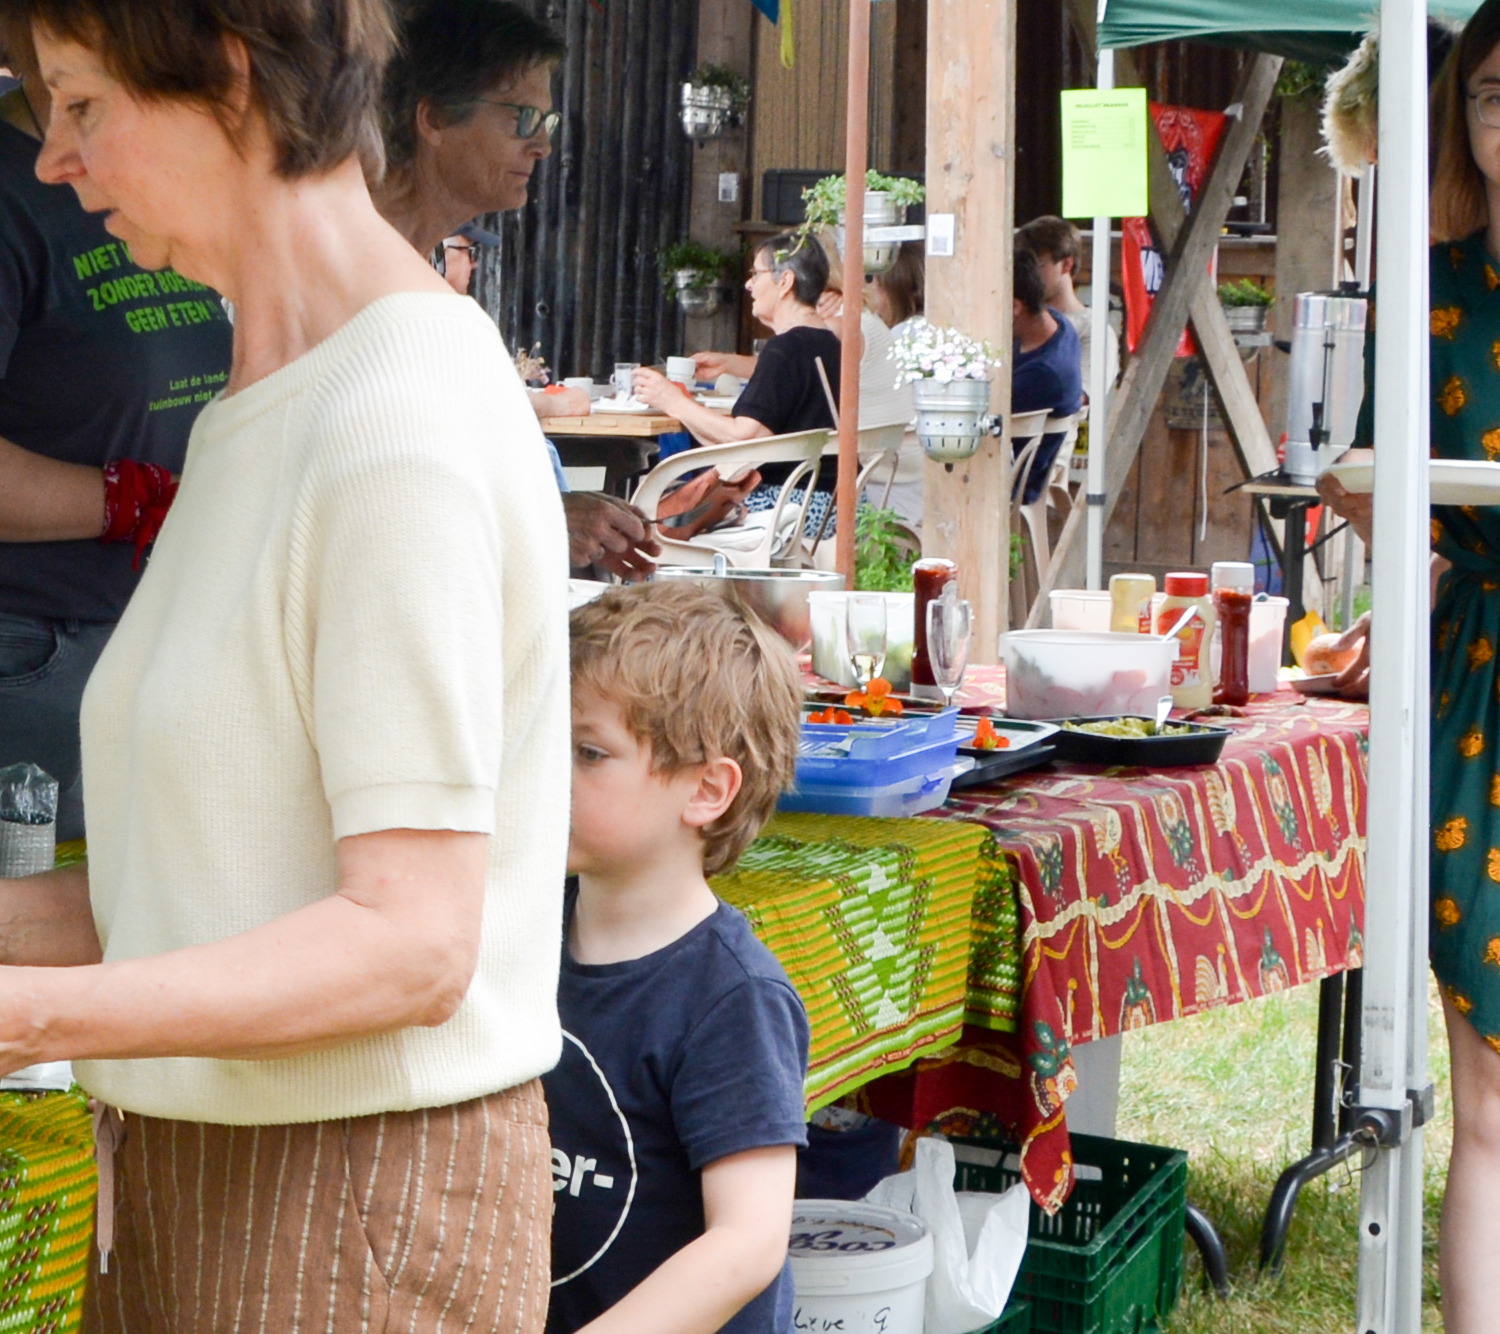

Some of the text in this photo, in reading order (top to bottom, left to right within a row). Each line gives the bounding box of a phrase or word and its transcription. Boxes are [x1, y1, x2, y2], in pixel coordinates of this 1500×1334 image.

[73, 243, 121, 280] NIET
[86, 272, 160, 312] ZONDER
[125, 305, 169, 334] GEEN
[167, 300, 212, 327] ETEN
